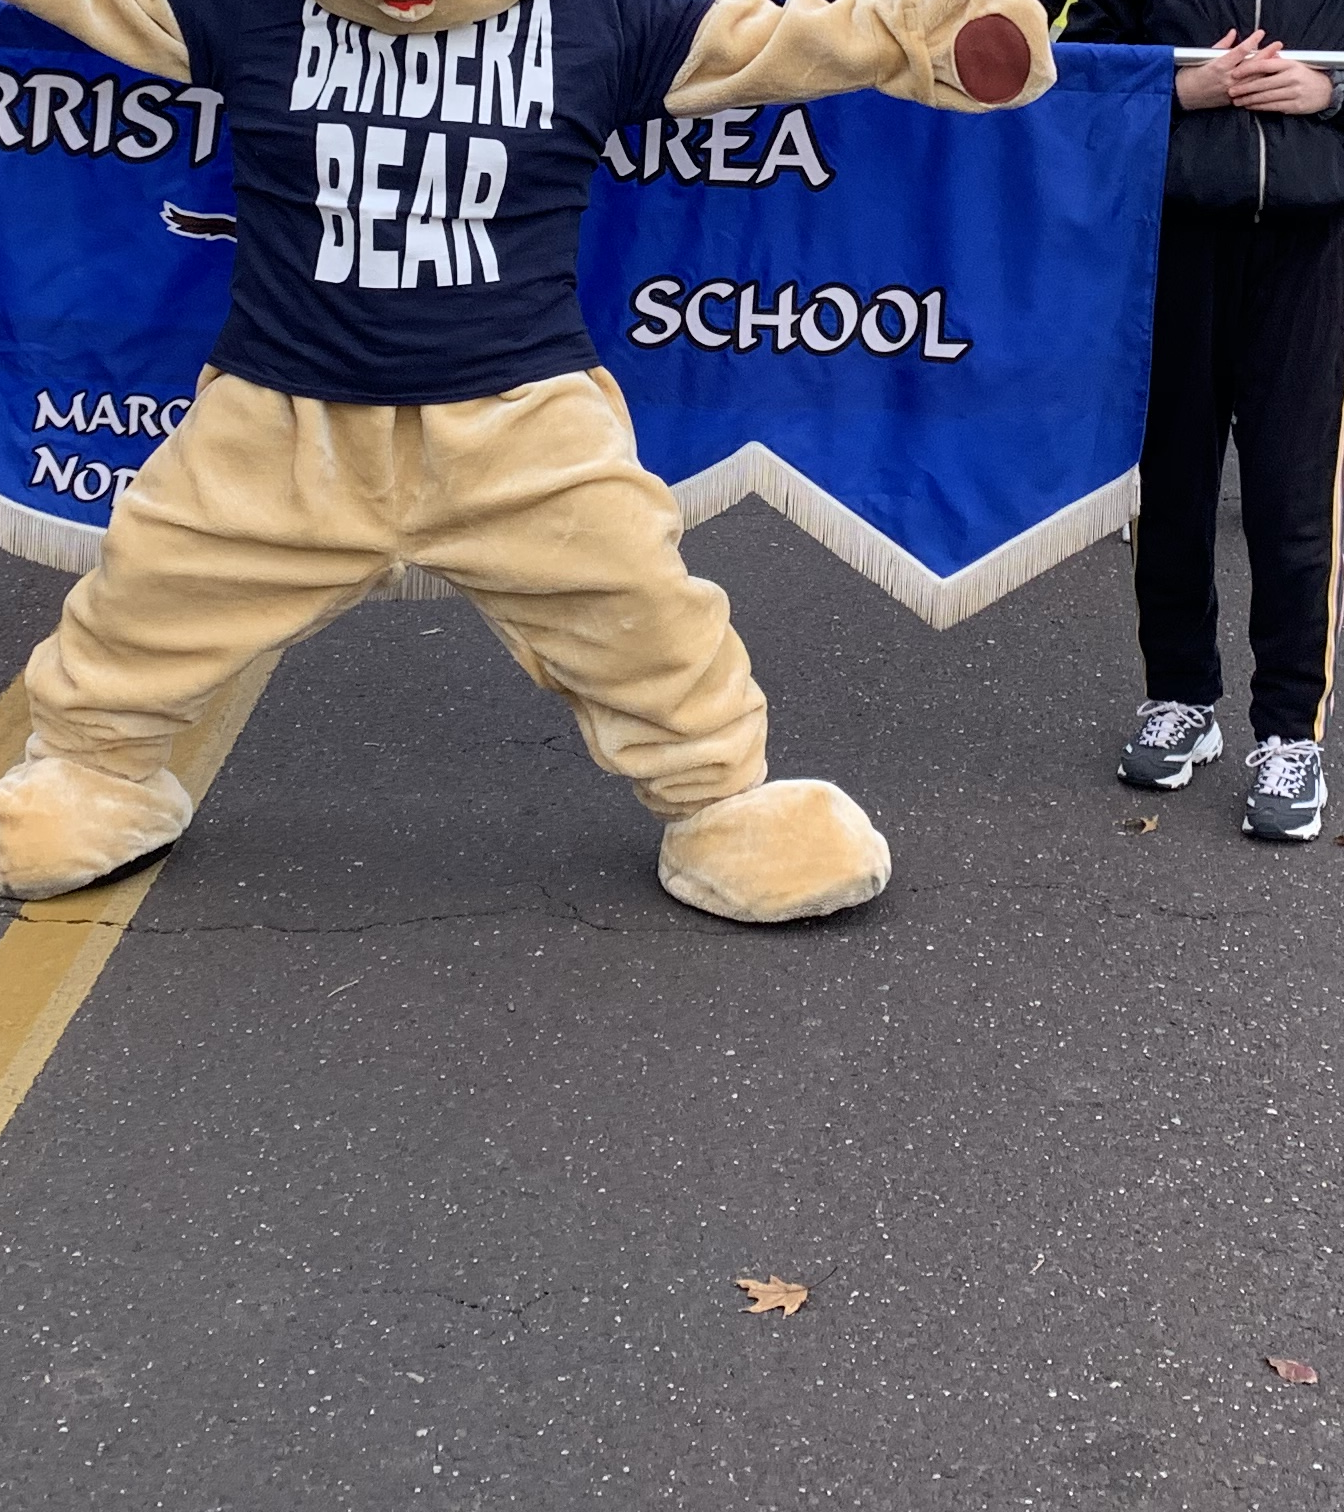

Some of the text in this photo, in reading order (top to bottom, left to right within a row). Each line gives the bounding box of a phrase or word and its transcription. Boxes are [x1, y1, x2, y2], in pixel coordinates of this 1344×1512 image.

[314, 122, 508, 290] BEAR
[630, 278, 971, 360] SCHOOL
[33, 389, 193, 439] MARC
